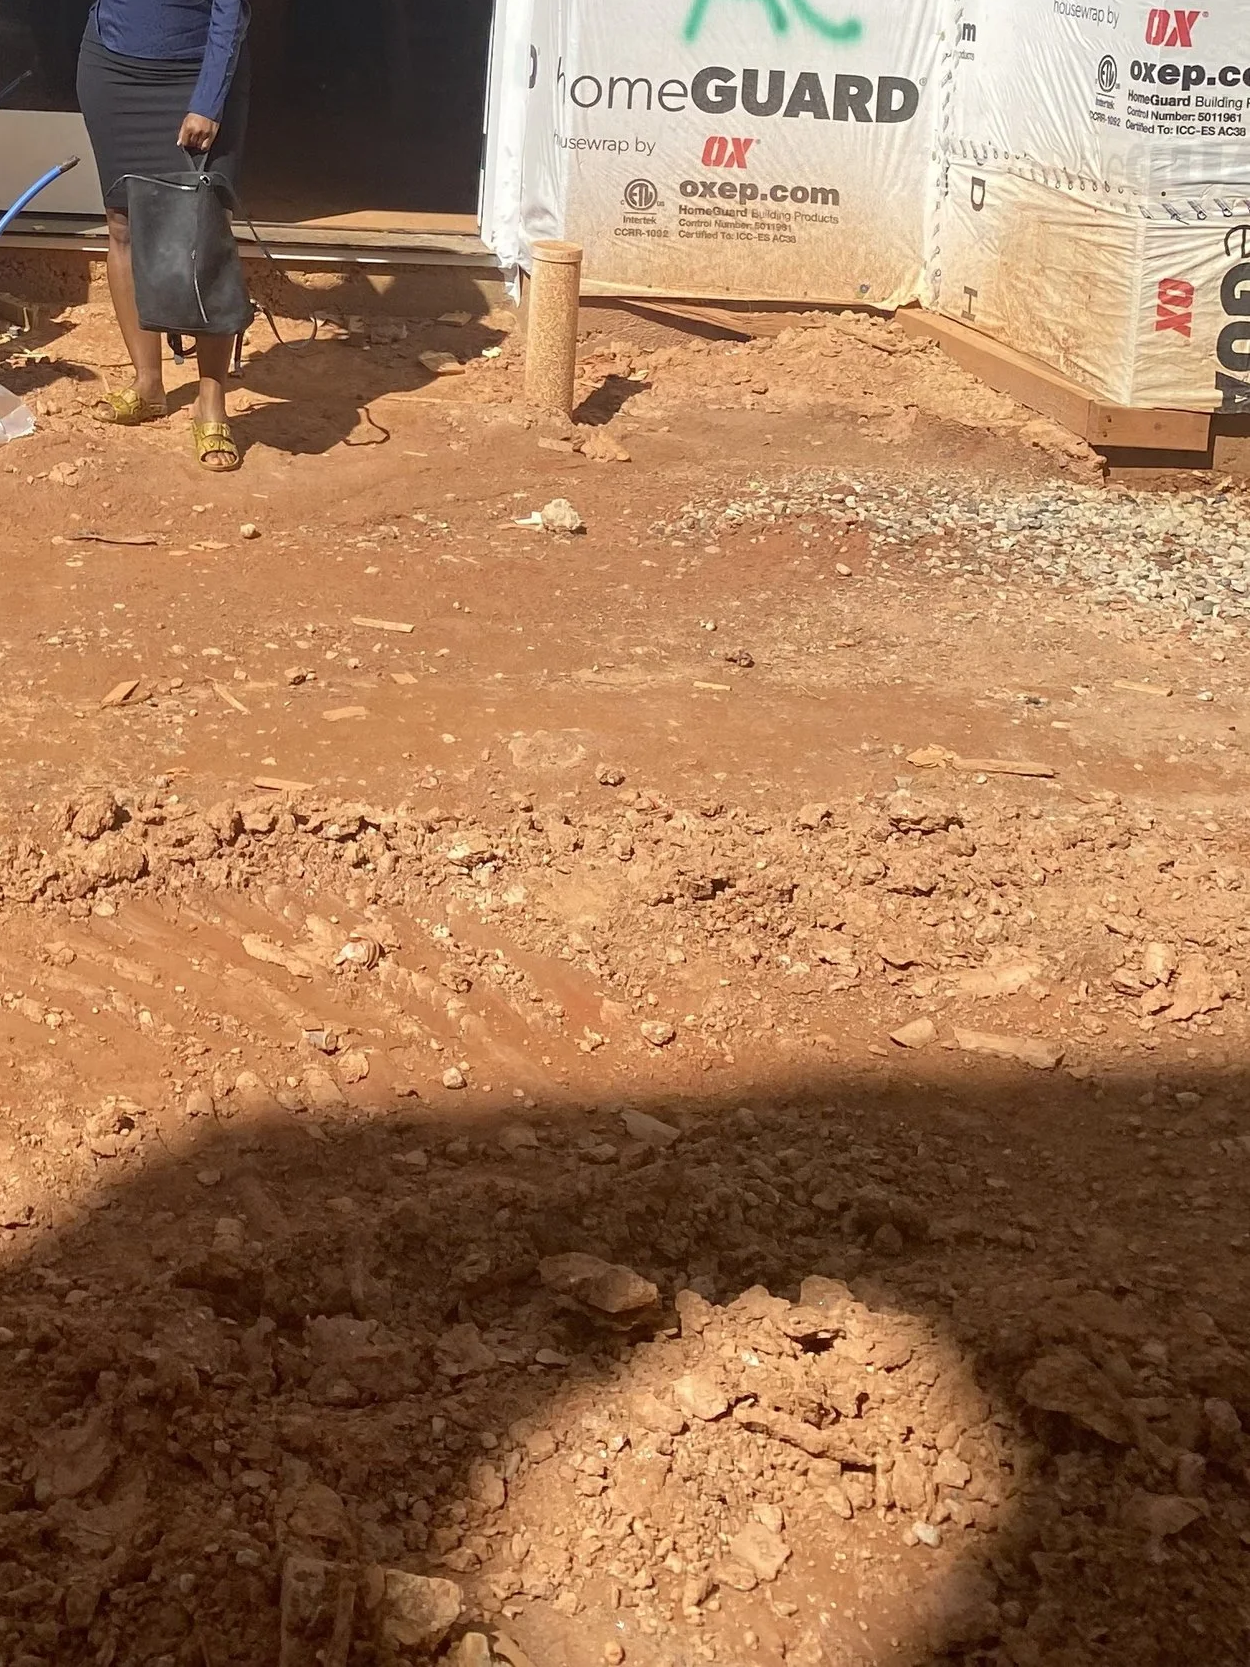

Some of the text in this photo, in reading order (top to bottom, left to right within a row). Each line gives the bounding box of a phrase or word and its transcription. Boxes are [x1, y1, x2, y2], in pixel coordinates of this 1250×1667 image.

[1107, 6, 1119, 29] by
[1145, 8, 1201, 48] OX
[557, 56, 919, 123] homeGUARD
[1128, 90, 1191, 107] HomeGuard
[1195, 96, 1243, 111] Building
[1151, 111, 1195, 122] Number:
[1198, 113, 1242, 123] 5011961
[1157, 125, 1174, 134] To:
[1176, 125, 1215, 136] ICC-ES
[1218, 127, 1246, 137] AC38
[635, 138, 655, 156] by
[701, 136, 757, 168] OX
[680, 180, 840, 206] oxep.com
[622, 215, 657, 224] Intertek
[678, 205, 839, 225] HomeGuard Building Products
[678, 219, 712, 228] Control
[678, 230, 718, 240] Certified
[736, 233, 770, 242] ICC-ES
[1155, 278, 1195, 338] OX
